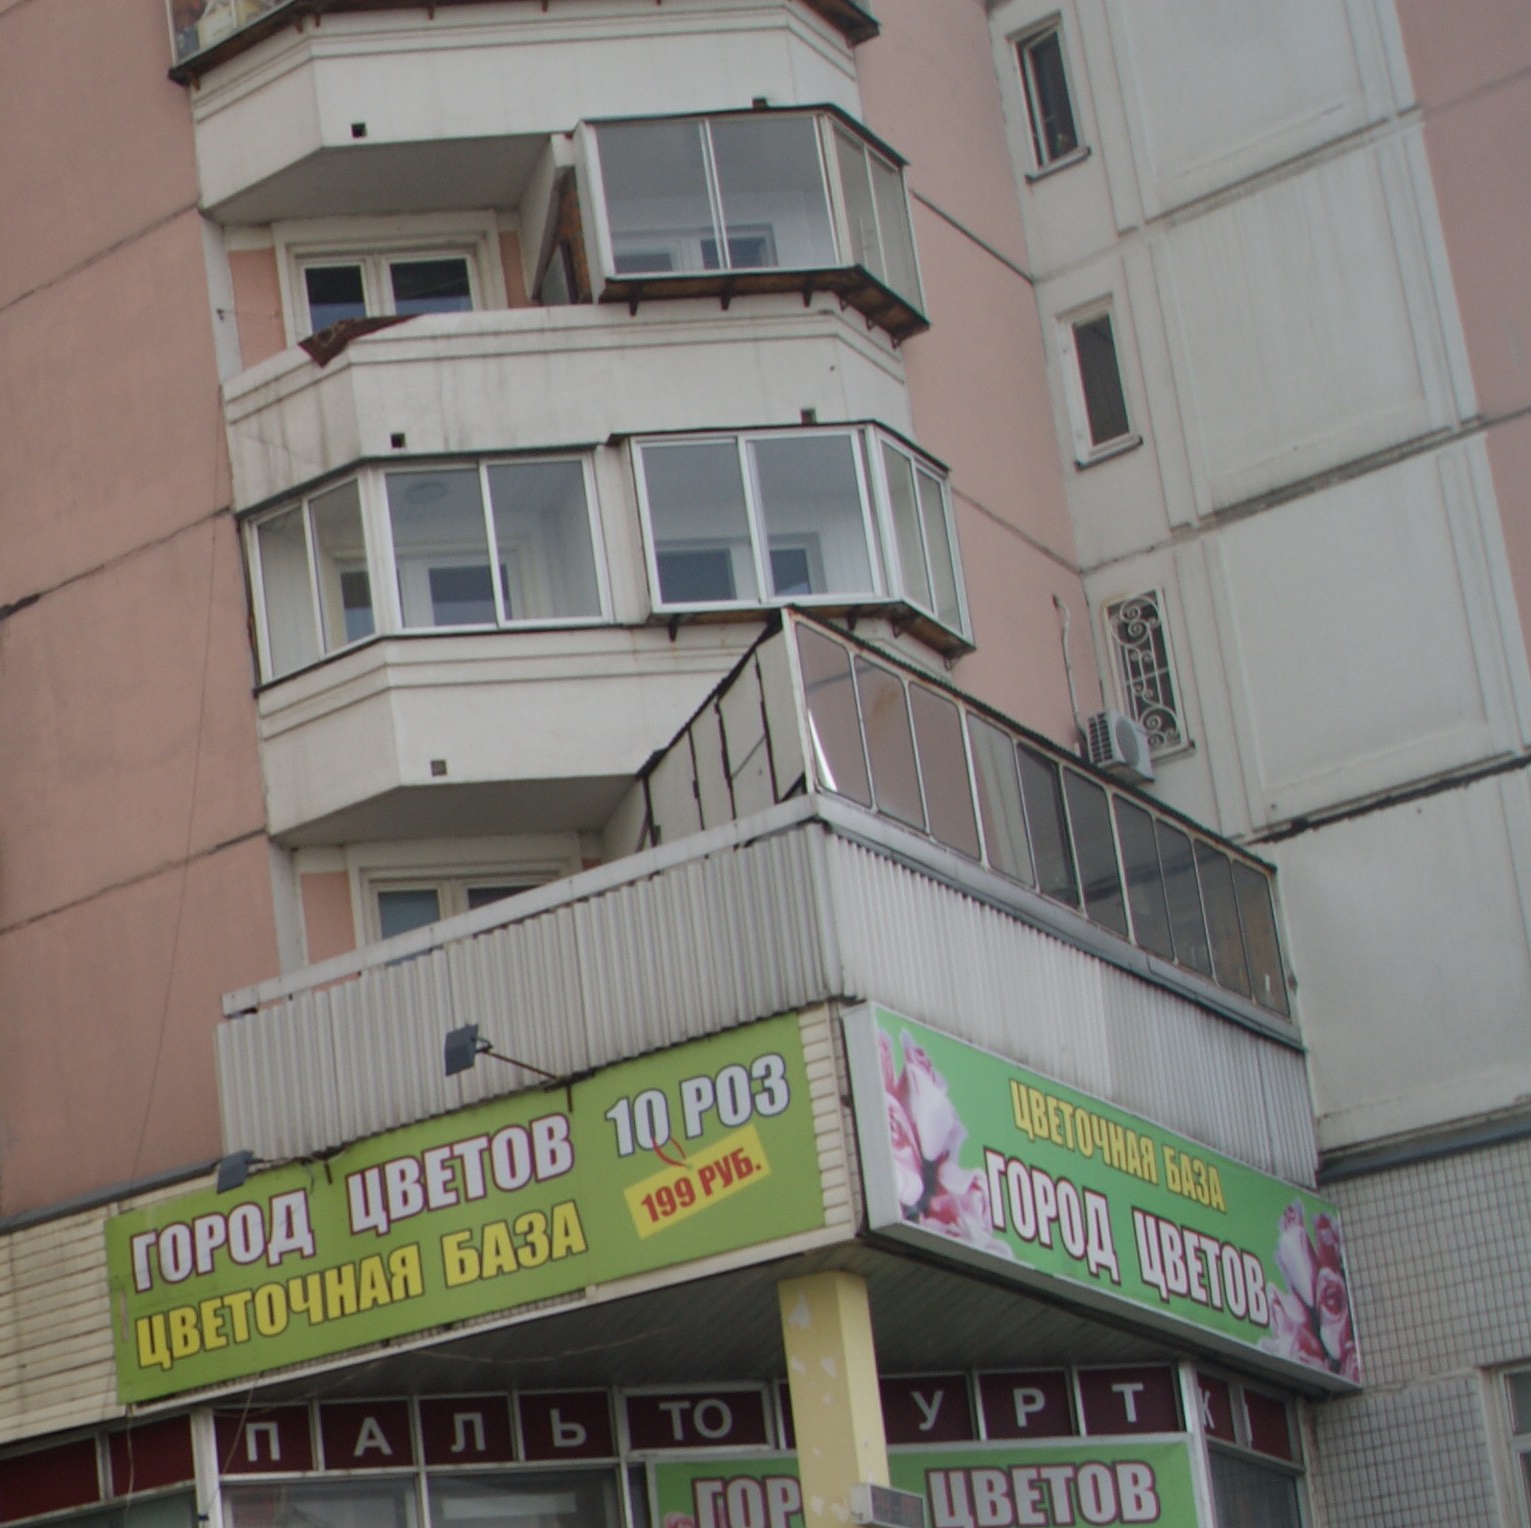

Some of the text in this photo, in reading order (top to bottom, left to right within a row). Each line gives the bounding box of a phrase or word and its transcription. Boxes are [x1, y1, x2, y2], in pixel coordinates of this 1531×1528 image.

[605, 1053, 790, 1157] 10 РОЗ
[1009, 1079, 1226, 1214] ЦВЕТОЧНАЯ БАЗА
[131, 1113, 574, 1293] ГОРОД ЦВЕТОВ
[640, 1154, 763, 1224] 199 РУБ.
[983, 1147, 1270, 1327] ГОРОД ЦВЕТОВ
[137, 1201, 589, 1372] ЦВЕТОЧНАЯ БАЗА
[247, 1399, 733, 1462] ПАЛЬТО
